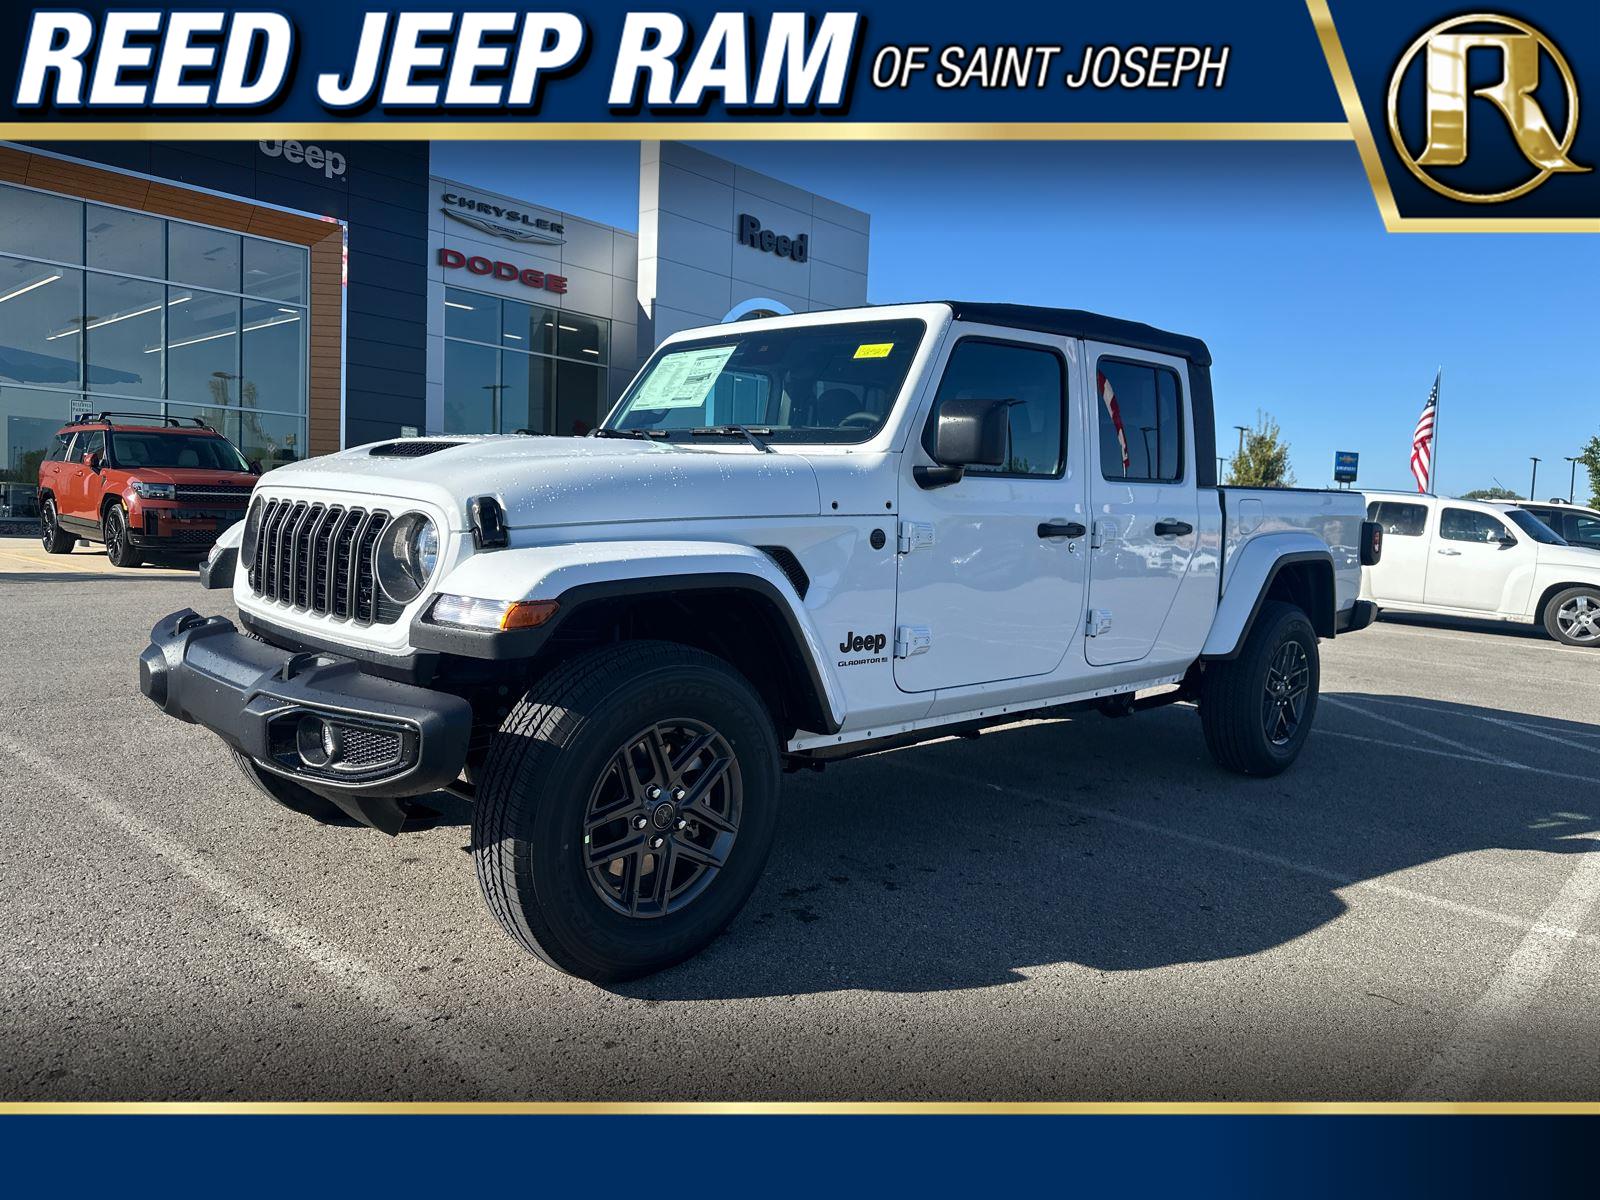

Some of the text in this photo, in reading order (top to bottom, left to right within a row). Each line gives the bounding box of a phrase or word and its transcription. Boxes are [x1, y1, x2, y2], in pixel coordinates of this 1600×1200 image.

[441, 193, 565, 235] CHRYSLER
[738, 213, 809, 264] Reed
[437, 247, 568, 295] DODGE
[837, 657, 881, 667] GLADIATOR
[839, 631, 887, 654] Jeep
